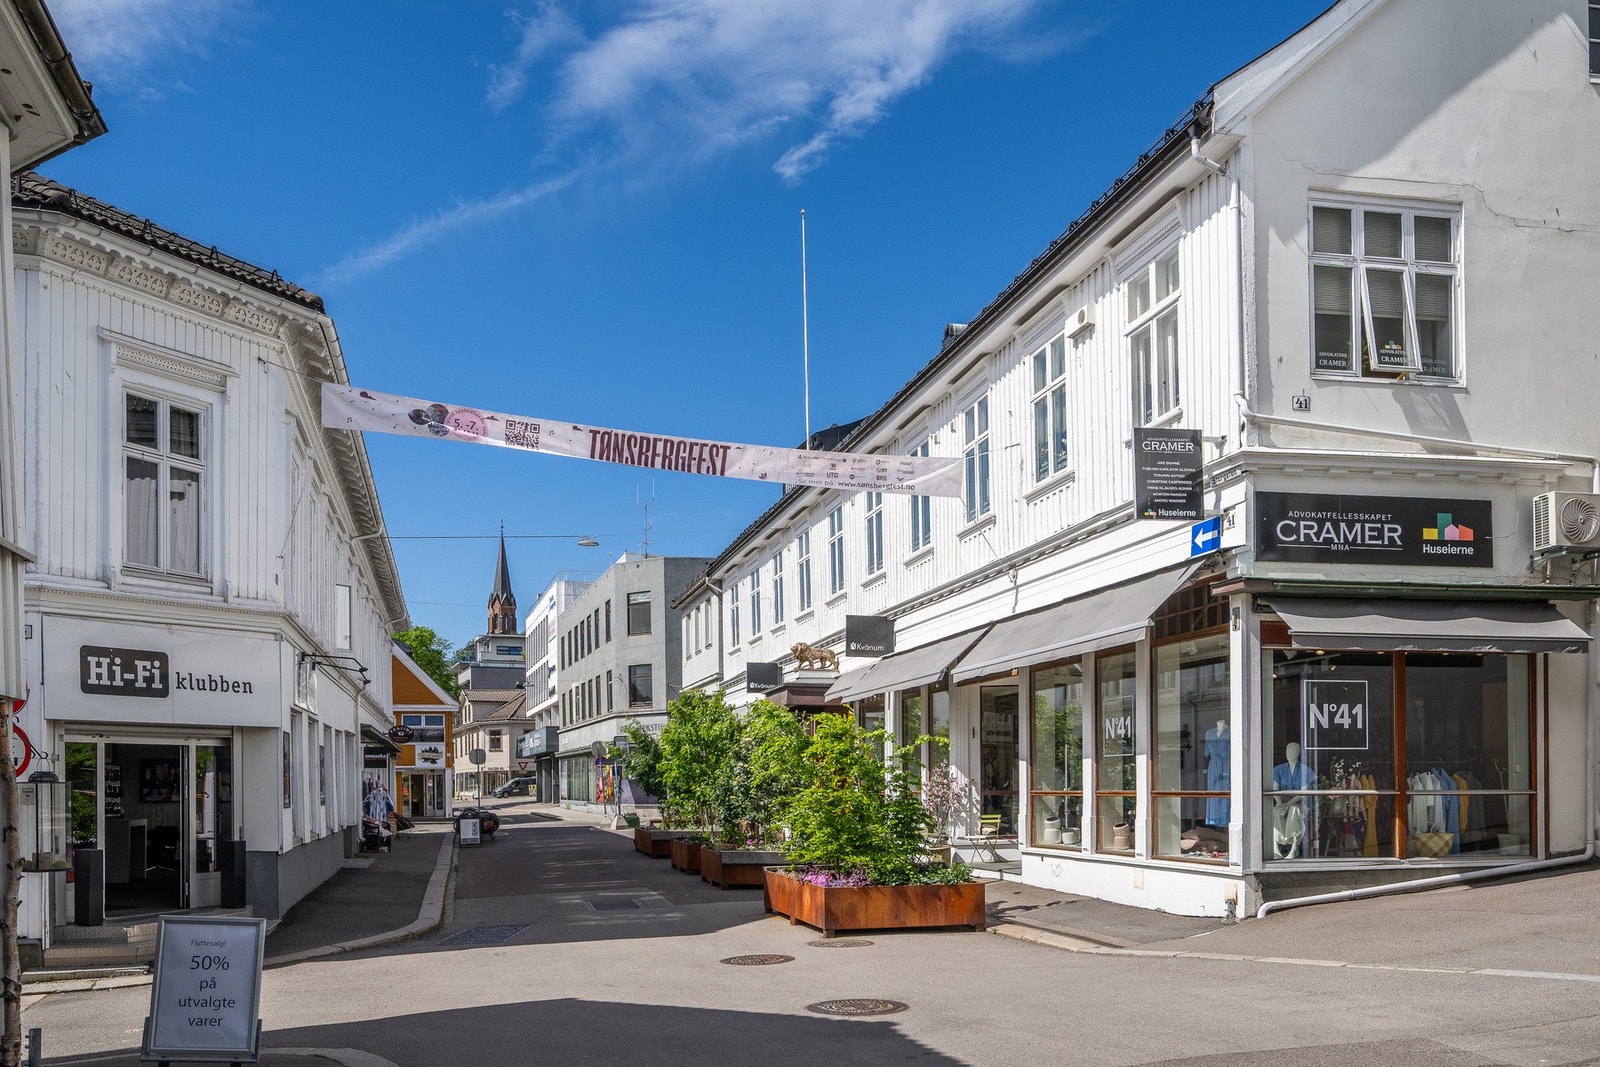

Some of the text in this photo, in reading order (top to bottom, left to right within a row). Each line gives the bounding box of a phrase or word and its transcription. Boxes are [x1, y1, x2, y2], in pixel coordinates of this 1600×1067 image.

[1318, 358, 1348, 368] CRAMER
[1380, 355, 1409, 364] CRAMER
[1421, 366, 1447, 374] RAMER
[1295, 398, 1309, 409] 41
[453, 418, 463, 429] 5.
[1141, 441, 1194, 452] CRAMER
[589, 429, 731, 477] TØNSBERGFEST
[1158, 508, 1197, 517] Huseierne
[1288, 510, 1392, 521] ADVOKATFELLESSKAPET
[1226, 514, 1236, 527] 41
[1276, 520, 1403, 545] CRAMER
[1330, 543, 1350, 551] MNA
[1422, 543, 1474, 555] Huseierne
[87, 656, 254, 694] Hi-Fi klubben
[190, 939, 227, 948] Flyttesalg!
[189, 955, 230, 971] 50%
[199, 976, 217, 992] på
[178, 996, 236, 1011] utvalgte
[188, 1017, 224, 1027] varer
